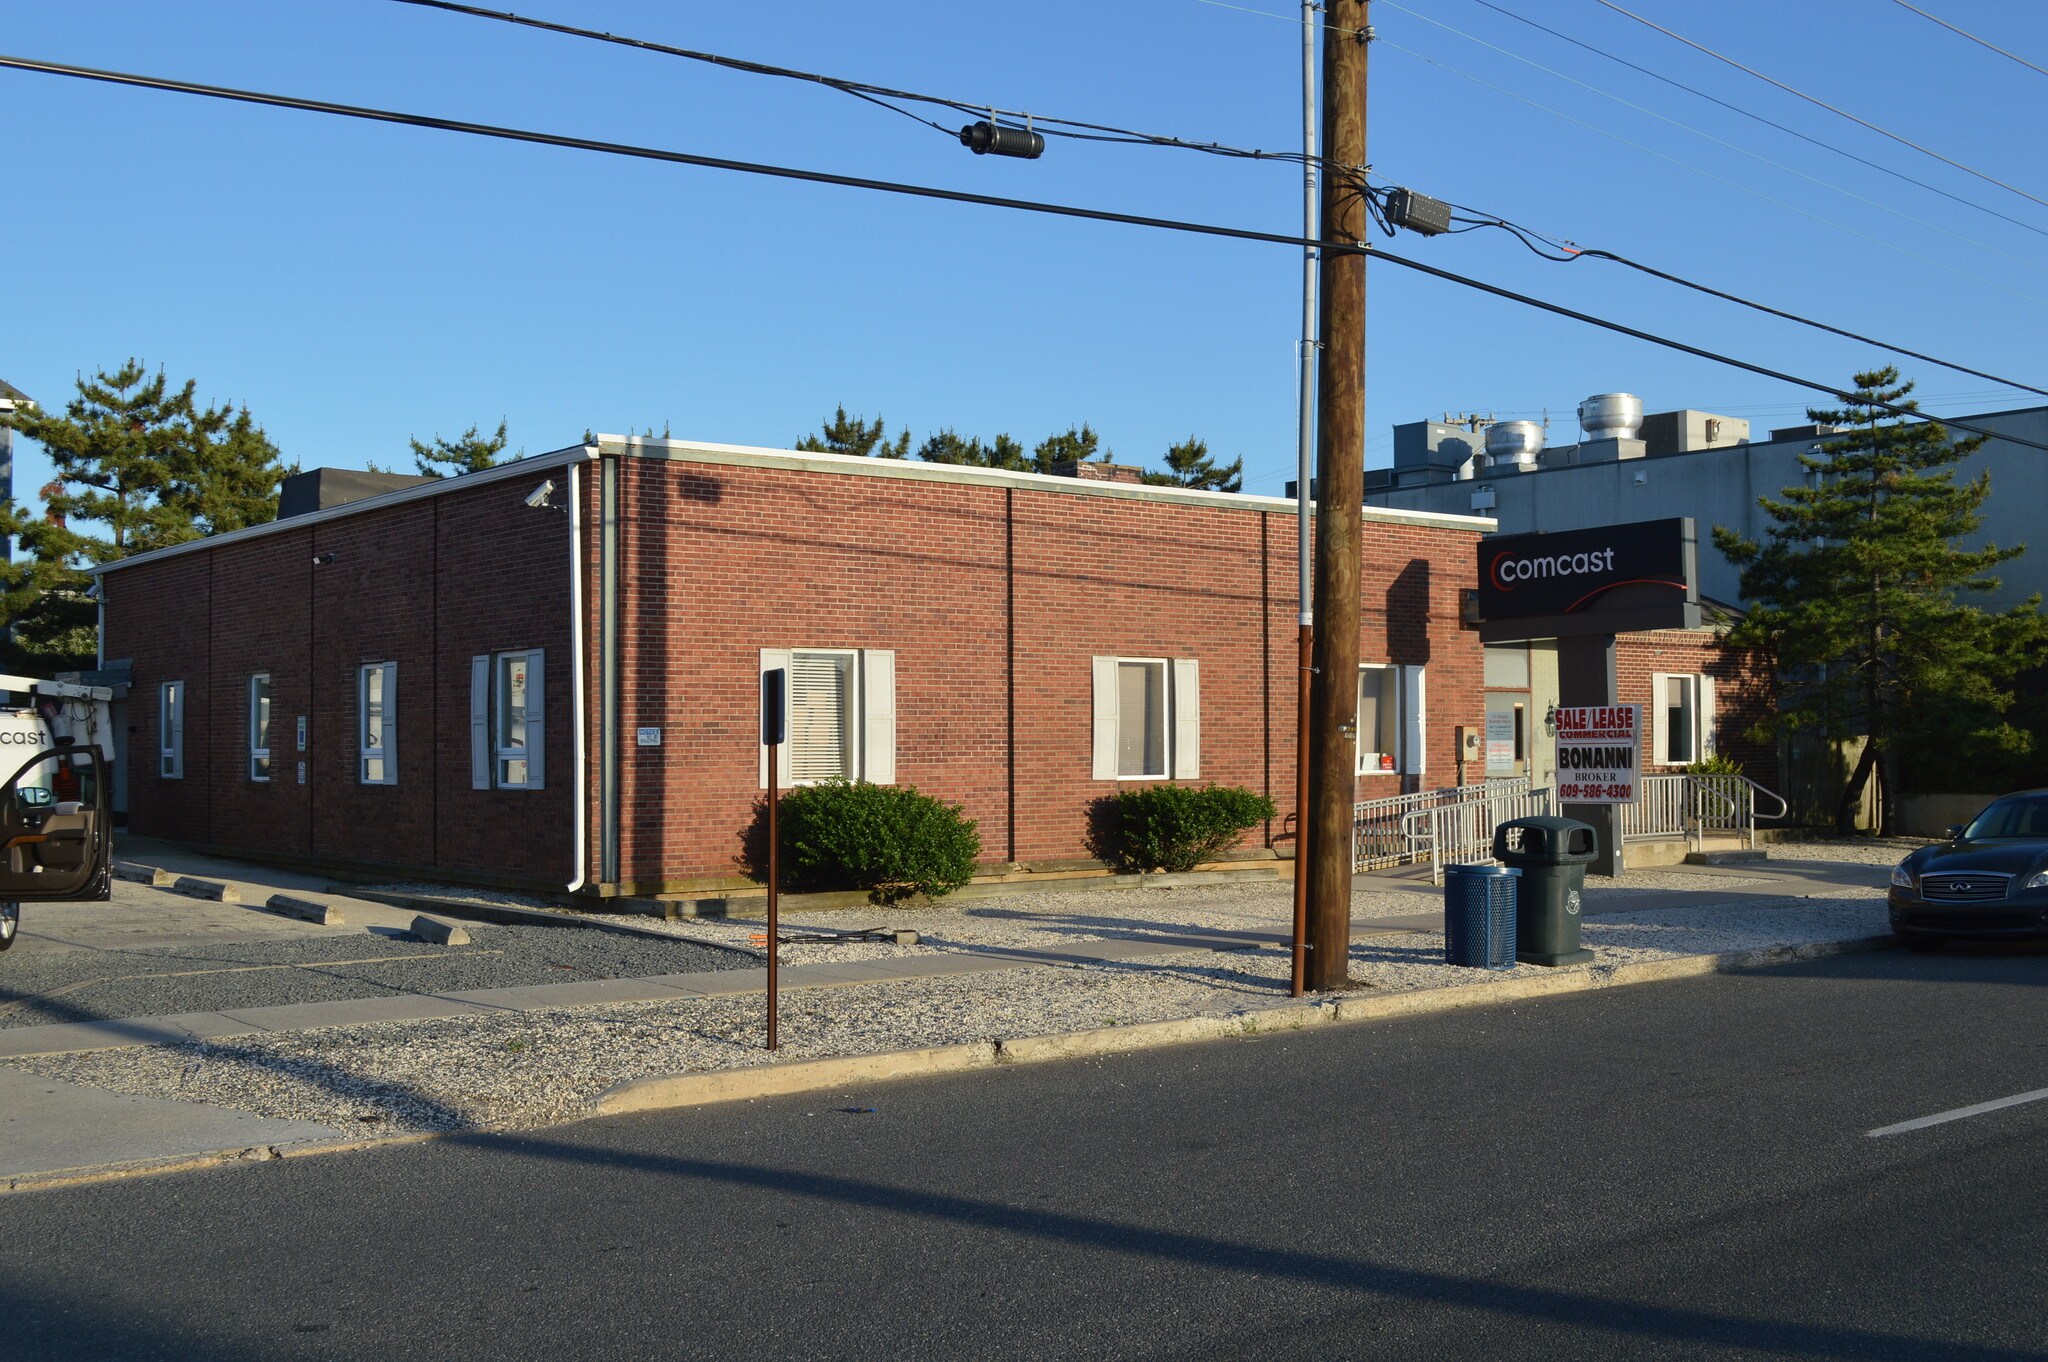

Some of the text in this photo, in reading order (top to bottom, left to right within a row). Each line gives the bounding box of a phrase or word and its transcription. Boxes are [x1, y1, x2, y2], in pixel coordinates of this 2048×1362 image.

[1499, 547, 1615, 582] comcast
[1555, 707, 1633, 730] SALE/LEASE
[0, 730, 46, 745] cast
[1559, 730, 1632, 739] COMMERCIAL
[1559, 747, 1633, 769] BONANNI
[1575, 772, 1617, 782] BROKER
[1560, 784, 1632, 799] 609-586-4300
